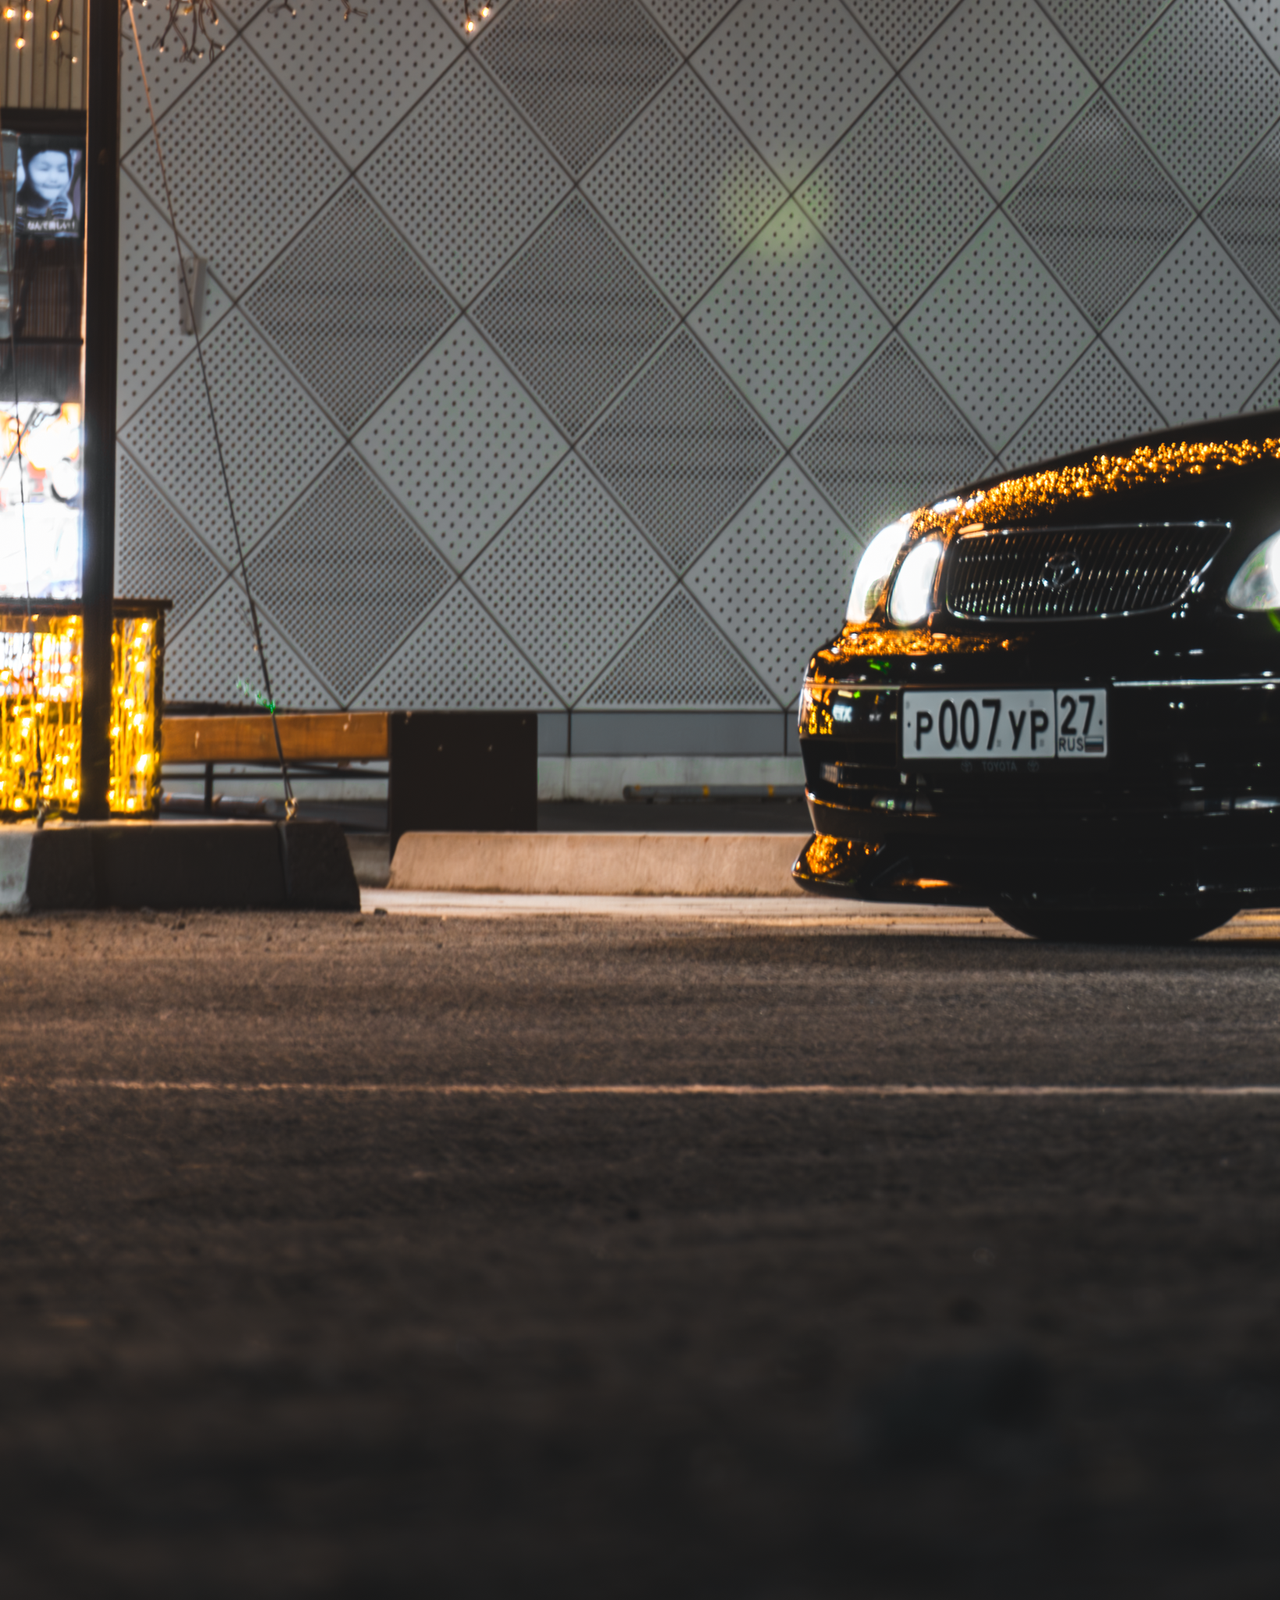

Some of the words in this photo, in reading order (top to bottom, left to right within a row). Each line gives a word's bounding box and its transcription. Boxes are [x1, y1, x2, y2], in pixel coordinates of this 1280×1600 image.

[1060, 694, 1096, 735] 27
[1058, 737, 1084, 752] RUS
[981, 760, 1018, 772] TOYOTA
